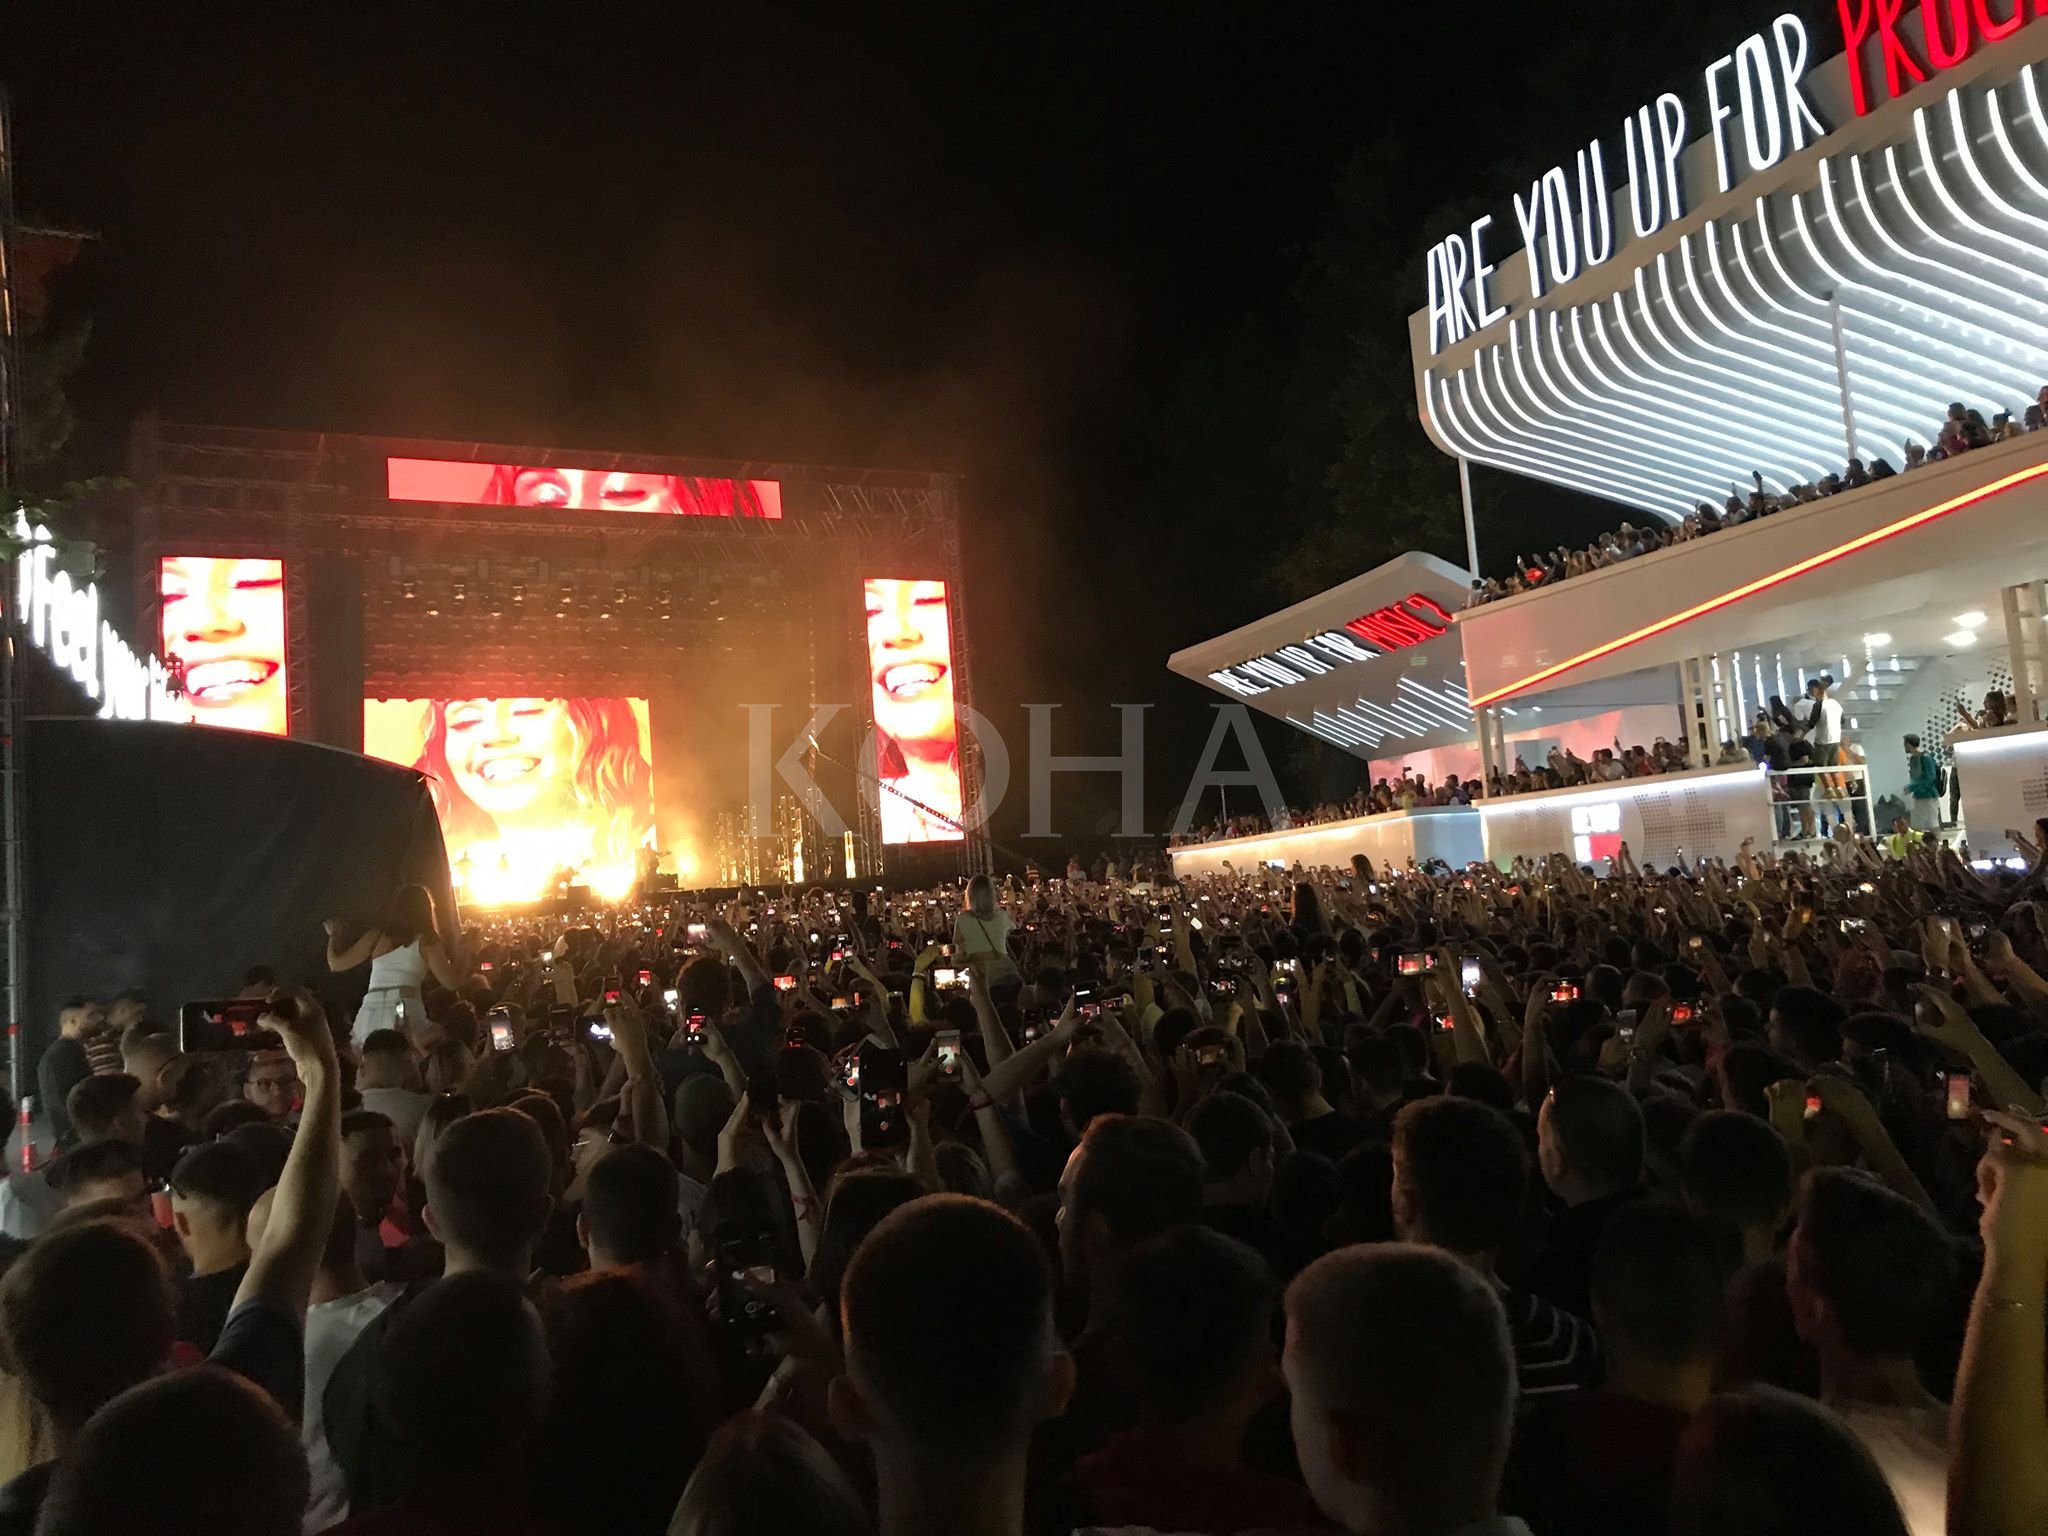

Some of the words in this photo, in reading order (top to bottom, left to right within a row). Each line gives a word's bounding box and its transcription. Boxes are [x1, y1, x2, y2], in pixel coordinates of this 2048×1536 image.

[1427, 214, 1508, 356] ARE
[1513, 138, 1611, 298] YOU
[1623, 92, 1685, 238] UP
[1704, 13, 1825, 193] FOR
[1274, 645, 1335, 675] UP
[1303, 631, 1381, 664] FOR
[1207, 668, 1271, 697] ARE
[1235, 656, 1307, 688] YOU
